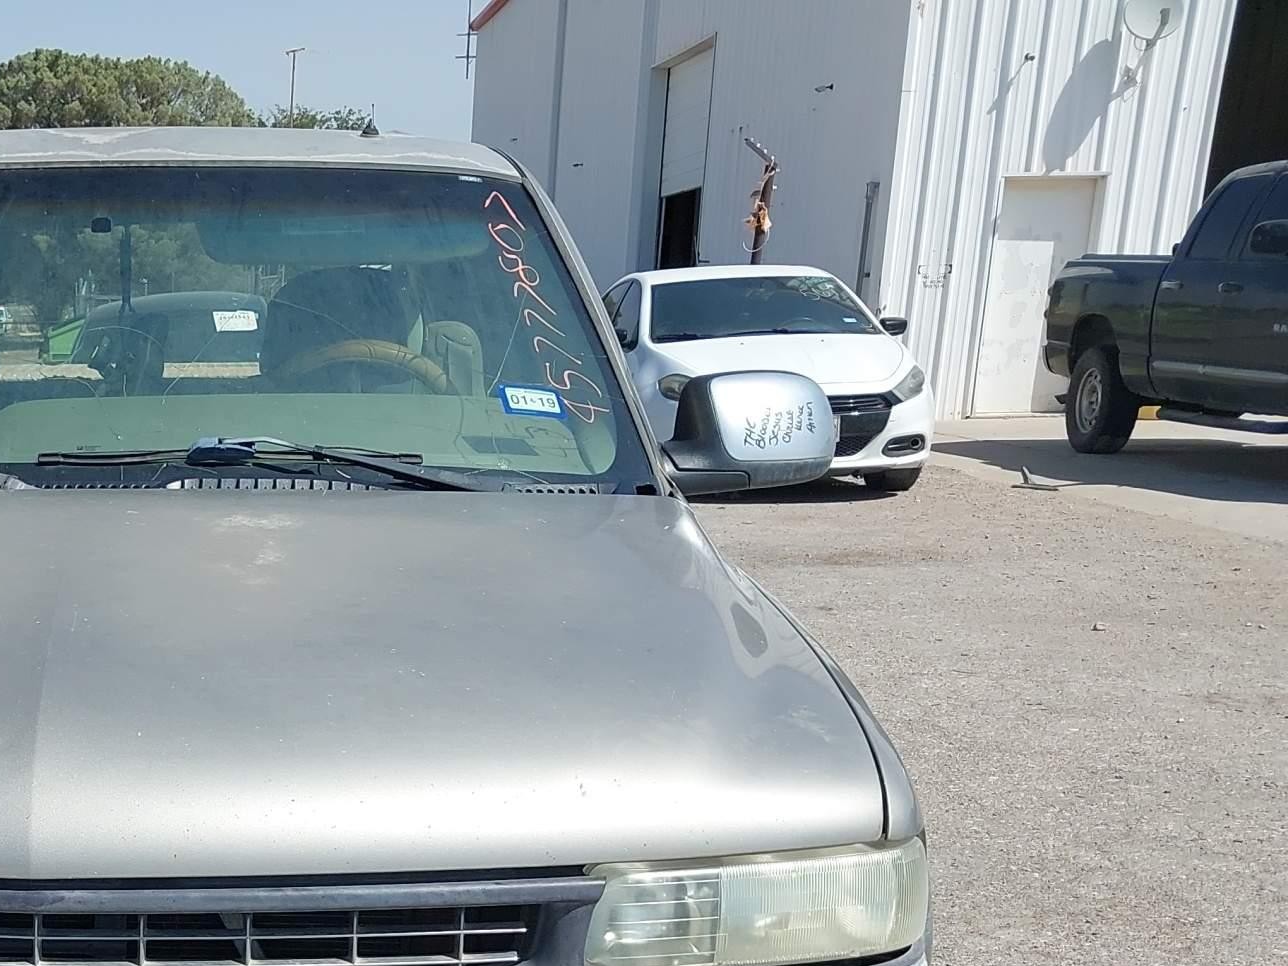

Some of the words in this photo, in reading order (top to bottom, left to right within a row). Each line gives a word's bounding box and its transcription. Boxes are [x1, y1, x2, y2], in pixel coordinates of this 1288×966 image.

[484, 191, 610, 423] 45777807
[510, 394, 528, 406] 01
[538, 397, 556, 409] 19
